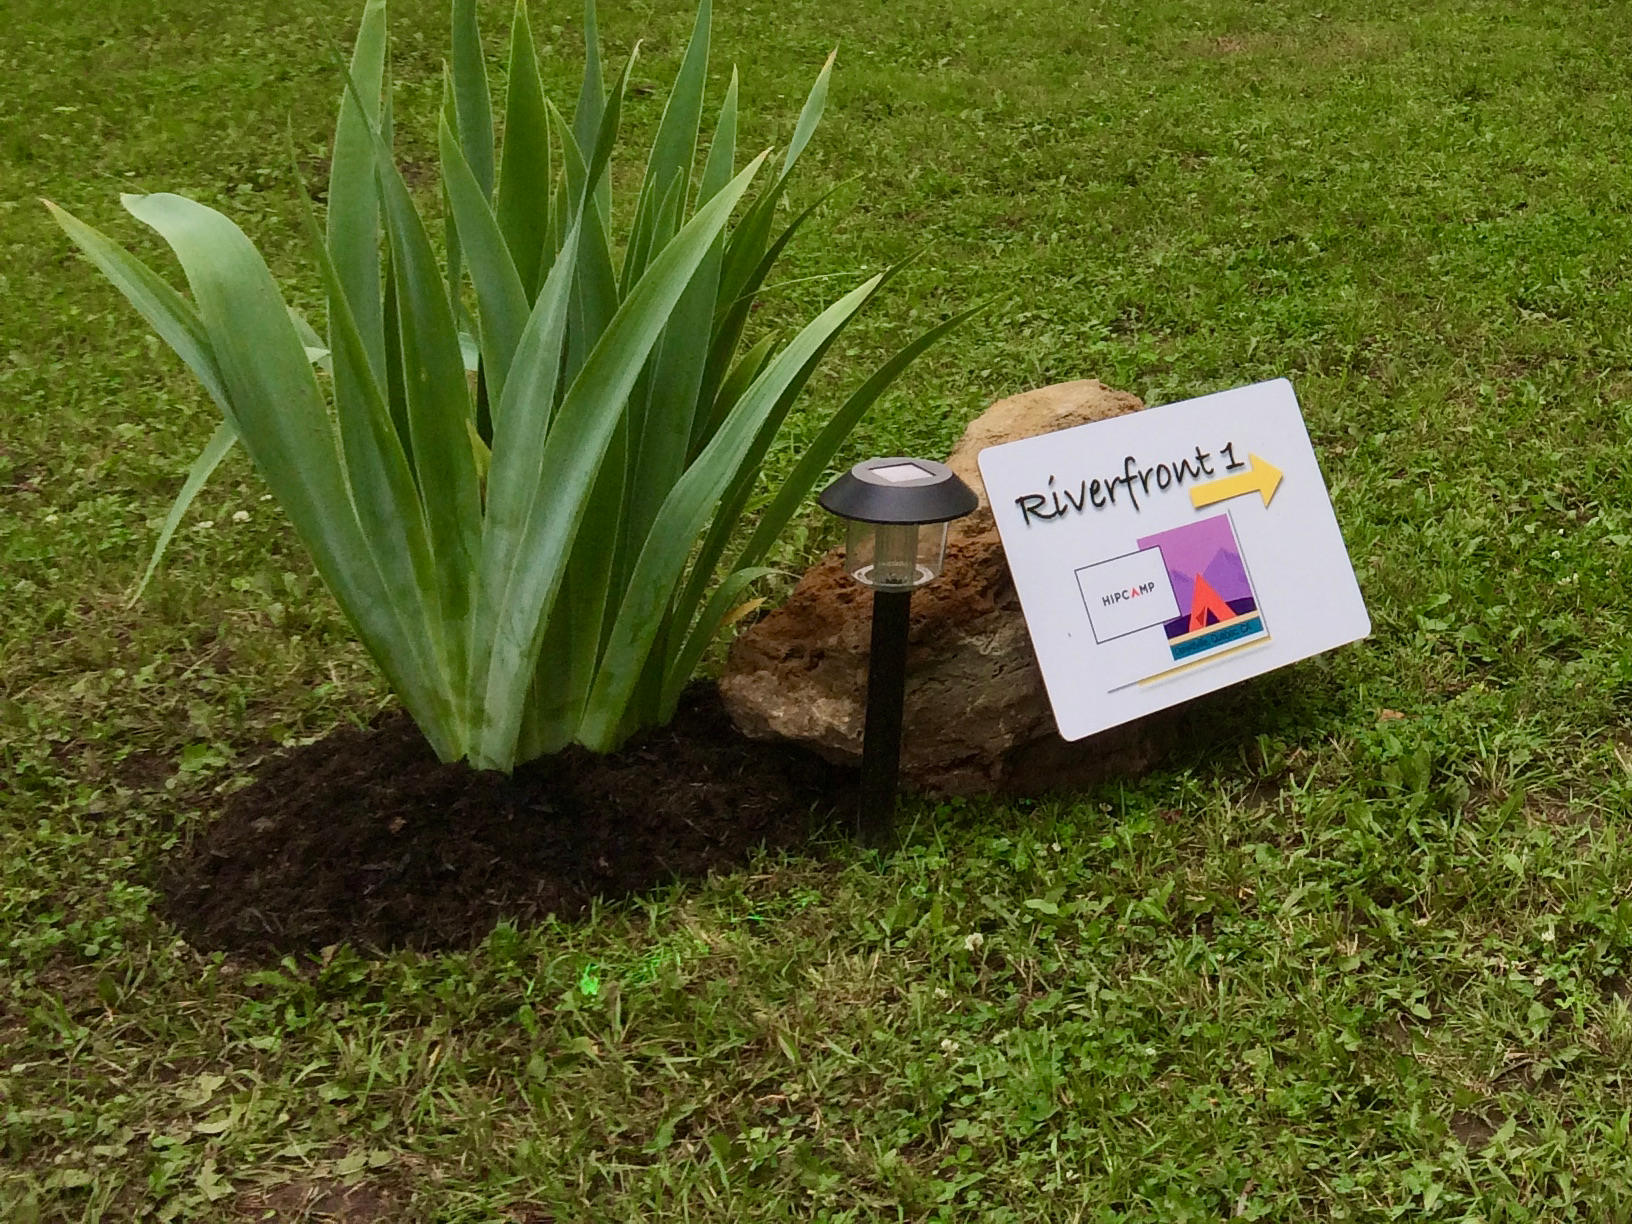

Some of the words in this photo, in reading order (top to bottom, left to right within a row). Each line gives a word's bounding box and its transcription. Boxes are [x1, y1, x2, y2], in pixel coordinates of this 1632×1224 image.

[1015, 446, 1214, 525] Riverfront
[1220, 442, 1244, 470] 1
[1102, 581, 1155, 606] HIPCAMP
